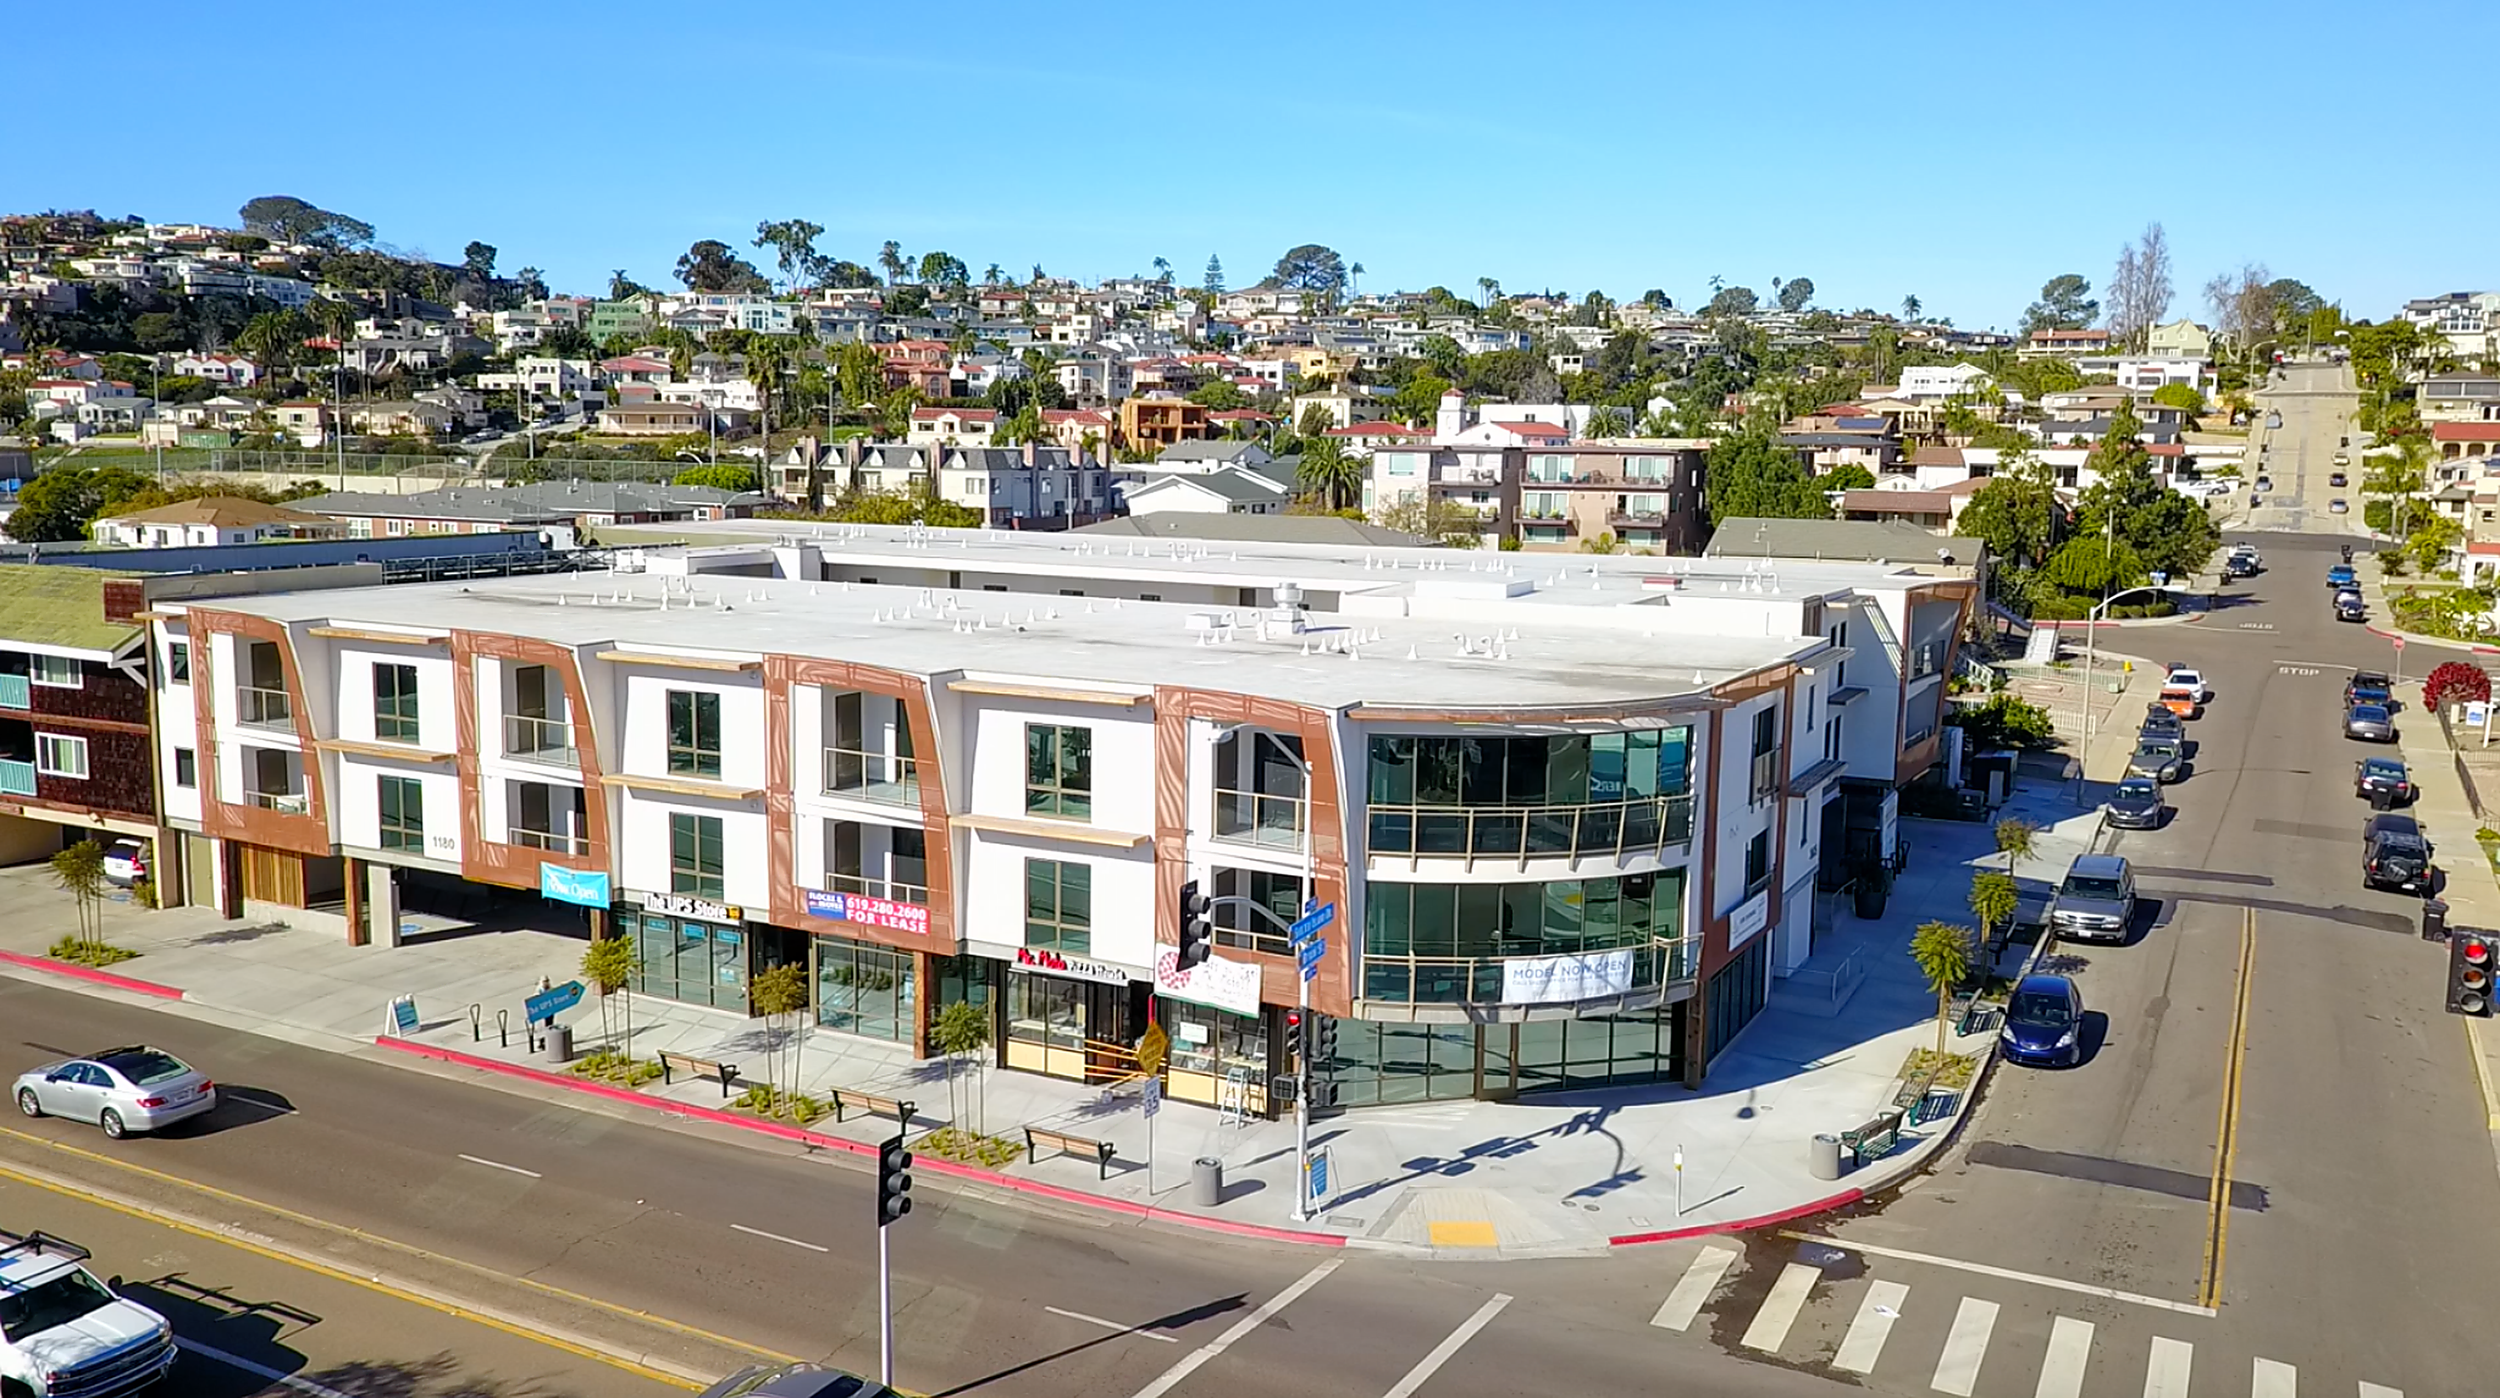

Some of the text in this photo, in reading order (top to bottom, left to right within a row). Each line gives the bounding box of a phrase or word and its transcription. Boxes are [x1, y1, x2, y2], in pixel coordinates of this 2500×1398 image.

[2278, 666, 2320, 677] STOP
[432, 836, 455, 850] 1180
[546, 877, 599, 901] Now Open
[642, 892, 727, 919] The UPS Store
[846, 897, 927, 921] 619.280.2600
[846, 909, 927, 934] FOR LEASE
[1513, 967, 1554, 979] MODEL
[1561, 963, 1592, 977] NOW
[1595, 960, 1626, 974] OPEN
[1146, 1096, 1159, 1114] 35
